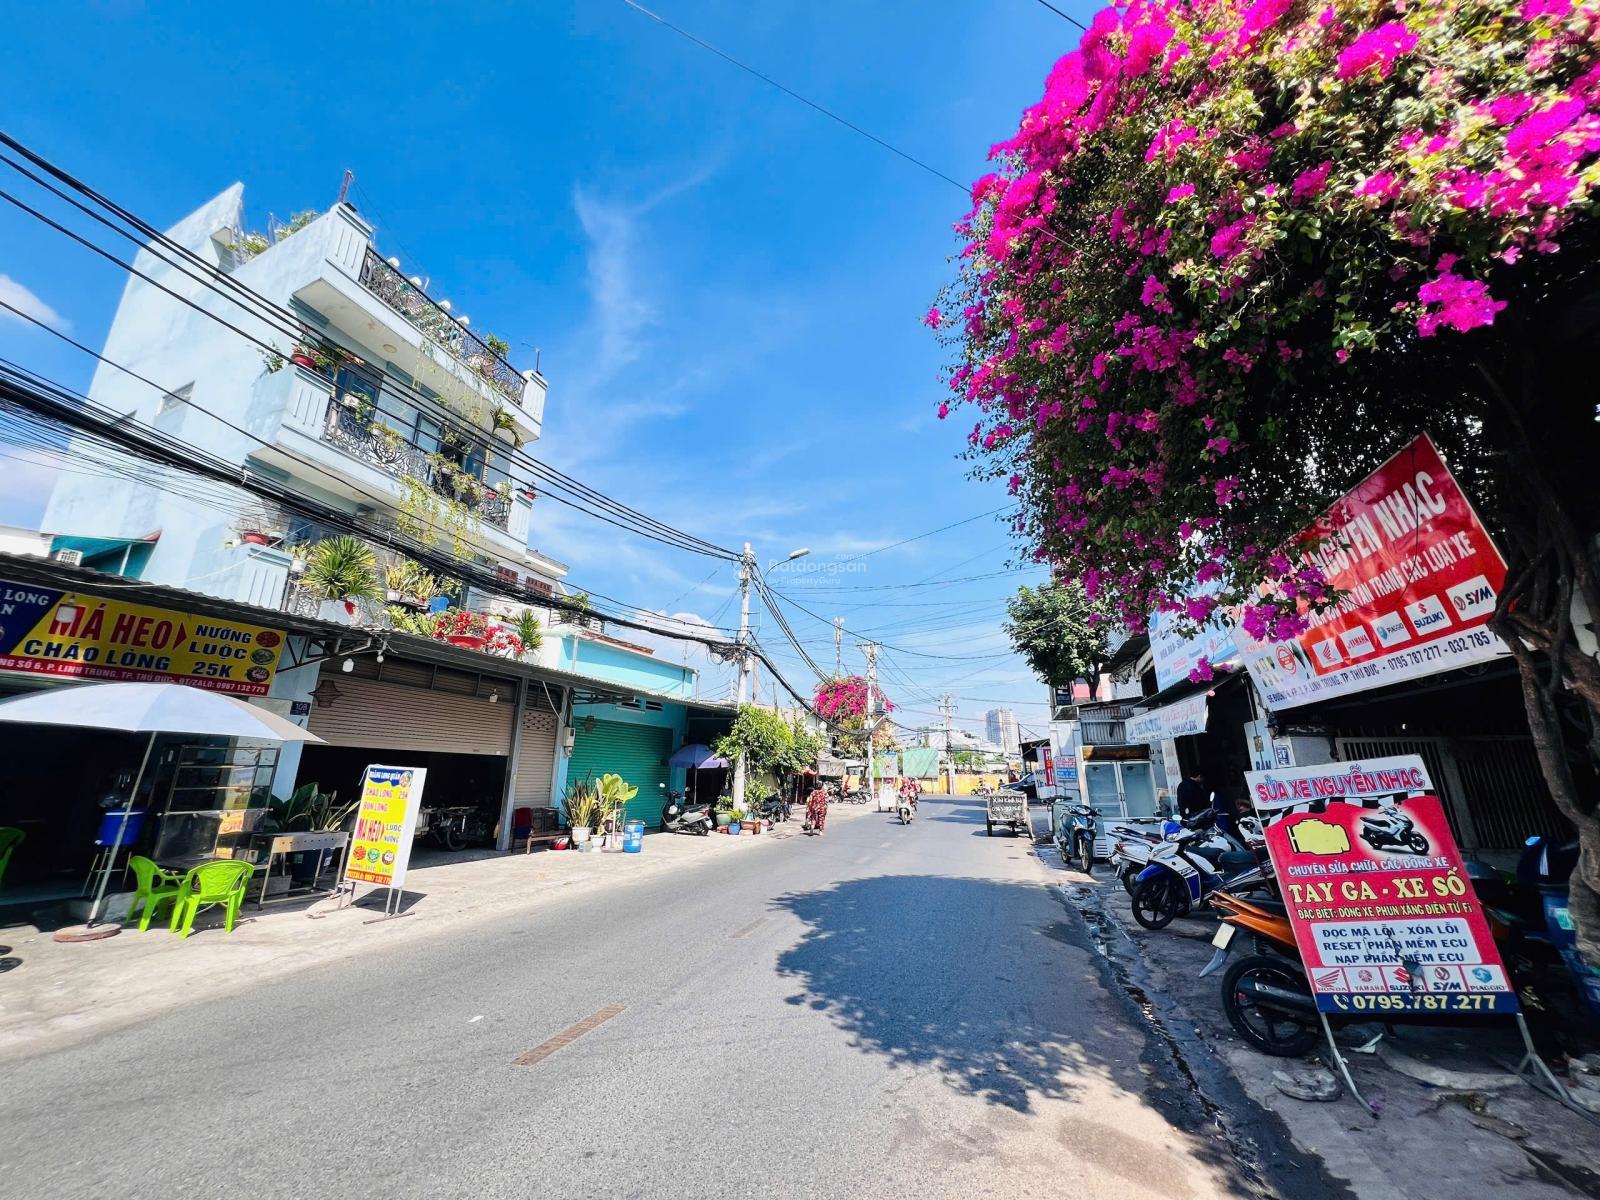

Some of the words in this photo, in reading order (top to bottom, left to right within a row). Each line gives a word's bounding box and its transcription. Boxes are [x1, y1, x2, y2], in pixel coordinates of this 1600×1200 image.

[1373, 471, 1446, 541] NHẠC
[1368, 566, 1406, 597] TRANG
[1400, 553, 1429, 583] CÁC
[1423, 539, 1458, 572] LOẠI
[1450, 530, 1476, 559] XE
[4, 589, 49, 605] LONG
[1465, 586, 1493, 605] SYM
[1413, 611, 1445, 628] SUZUKI
[110, 613, 173, 649] HEO
[195, 624, 252, 643] NƯỚNG
[24, 640, 99, 661] CHÁO
[106, 649, 171, 671] LÒNG
[192, 661, 233, 678] 25K
[189, 641, 247, 660] LUỘC
[1340, 672, 1351, 684] TP.
[1351, 666, 1364, 681] THỦ
[1388, 655, 1408, 670] 0795
[1407, 650, 1424, 665] 787
[1423, 645, 1442, 660] 277
[1448, 638, 1469, 654] 032
[1467, 631, 1490, 648] 785
[58, 664, 82, 674] LINH
[237, 684, 250, 692] 132
[1256, 774, 1289, 803] SỬA
[1289, 778, 1313, 800] XE
[1310, 764, 1378, 797] NGUYỄN
[1376, 766, 1425, 793] NHẠC
[1288, 863, 1327, 875] CHUYÊN
[1328, 860, 1349, 873] SỬA
[1349, 859, 1379, 872] CHỮA
[1381, 857, 1401, 870] CÁC
[1403, 854, 1432, 868] DÒNG
[1434, 857, 1449, 867] XE
[1288, 882, 1334, 903] TAY
[1341, 880, 1378, 900] GA
[1391, 878, 1429, 898] XE
[1432, 866, 1466, 897] SỐ
[1297, 907, 1315, 921] ĐẶC
[1316, 905, 1338, 921] BIỆT:
[1338, 904, 1361, 918] DÒNG
[1362, 906, 1375, 917] XE
[1375, 905, 1399, 917] PHUN
[1425, 901, 1447, 916] ĐIỆN
[1322, 928, 1347, 939] ĐỌC
[1351, 926, 1371, 936] MÃ
[1374, 923, 1395, 936] LỖI
[1406, 923, 1433, 934] XÓA
[1436, 921, 1459, 933] LỖI
[1323, 941, 1361, 950] RESET
[1367, 938, 1402, 950] PHẦN
[1405, 936, 1437, 948] MỀM
[1441, 939, 1468, 948] ECU
[1335, 955, 1359, 966] NẠP
[1364, 951, 1399, 963] PHẦN
[1404, 950, 1434, 962] MỀM
[1437, 953, 1465, 962] ECU
[1433, 982, 1461, 991] SYM
[1352, 994, 1496, 1009] 0795.787.277
